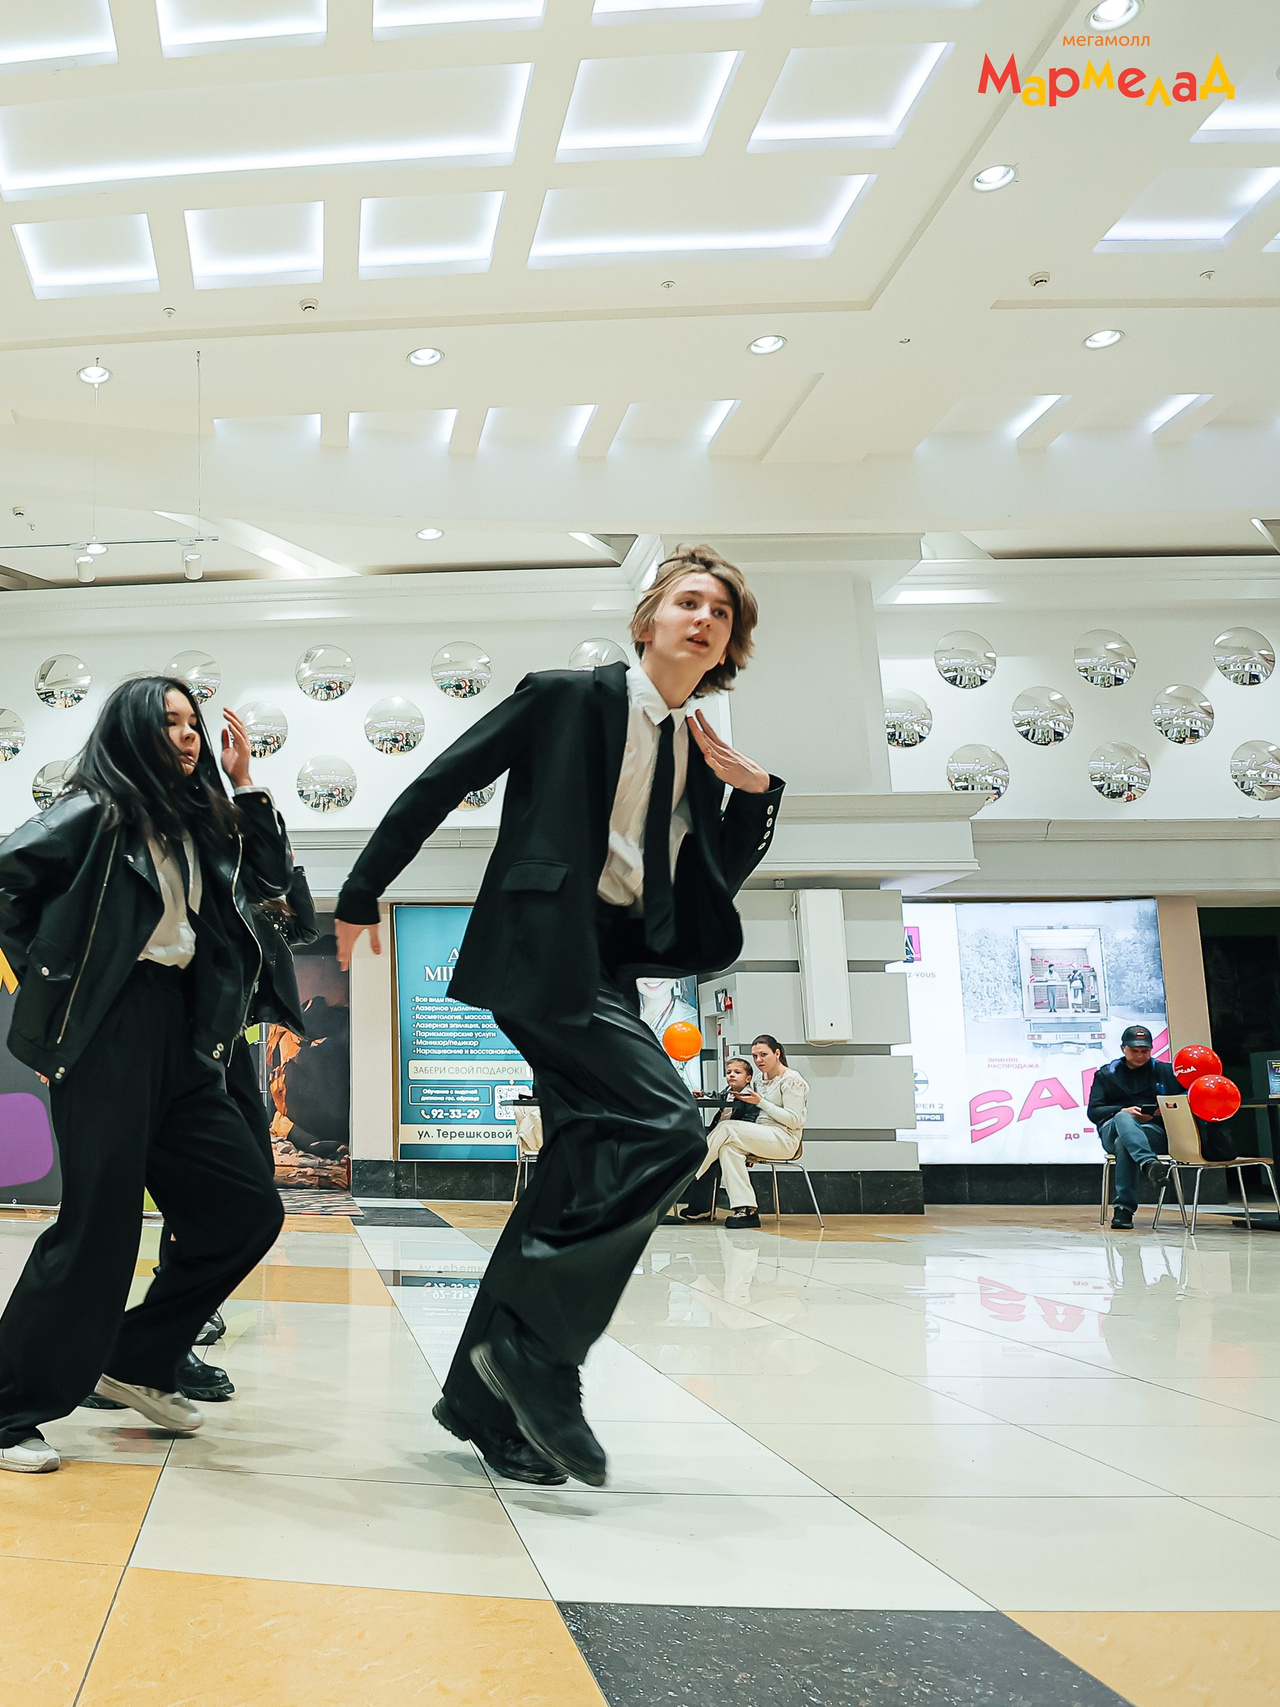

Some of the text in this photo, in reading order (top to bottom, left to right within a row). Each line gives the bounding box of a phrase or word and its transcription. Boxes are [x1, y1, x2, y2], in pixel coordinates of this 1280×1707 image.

[415, 1022, 449, 1030] Лазерная
[413, 1065, 523, 1075] ЗАБЕРИ СВОЙ ПОДАРОК!
[430, 1109, 480, 1119] 92-33-29
[417, 1129, 513, 1140] ул. Терешковой
